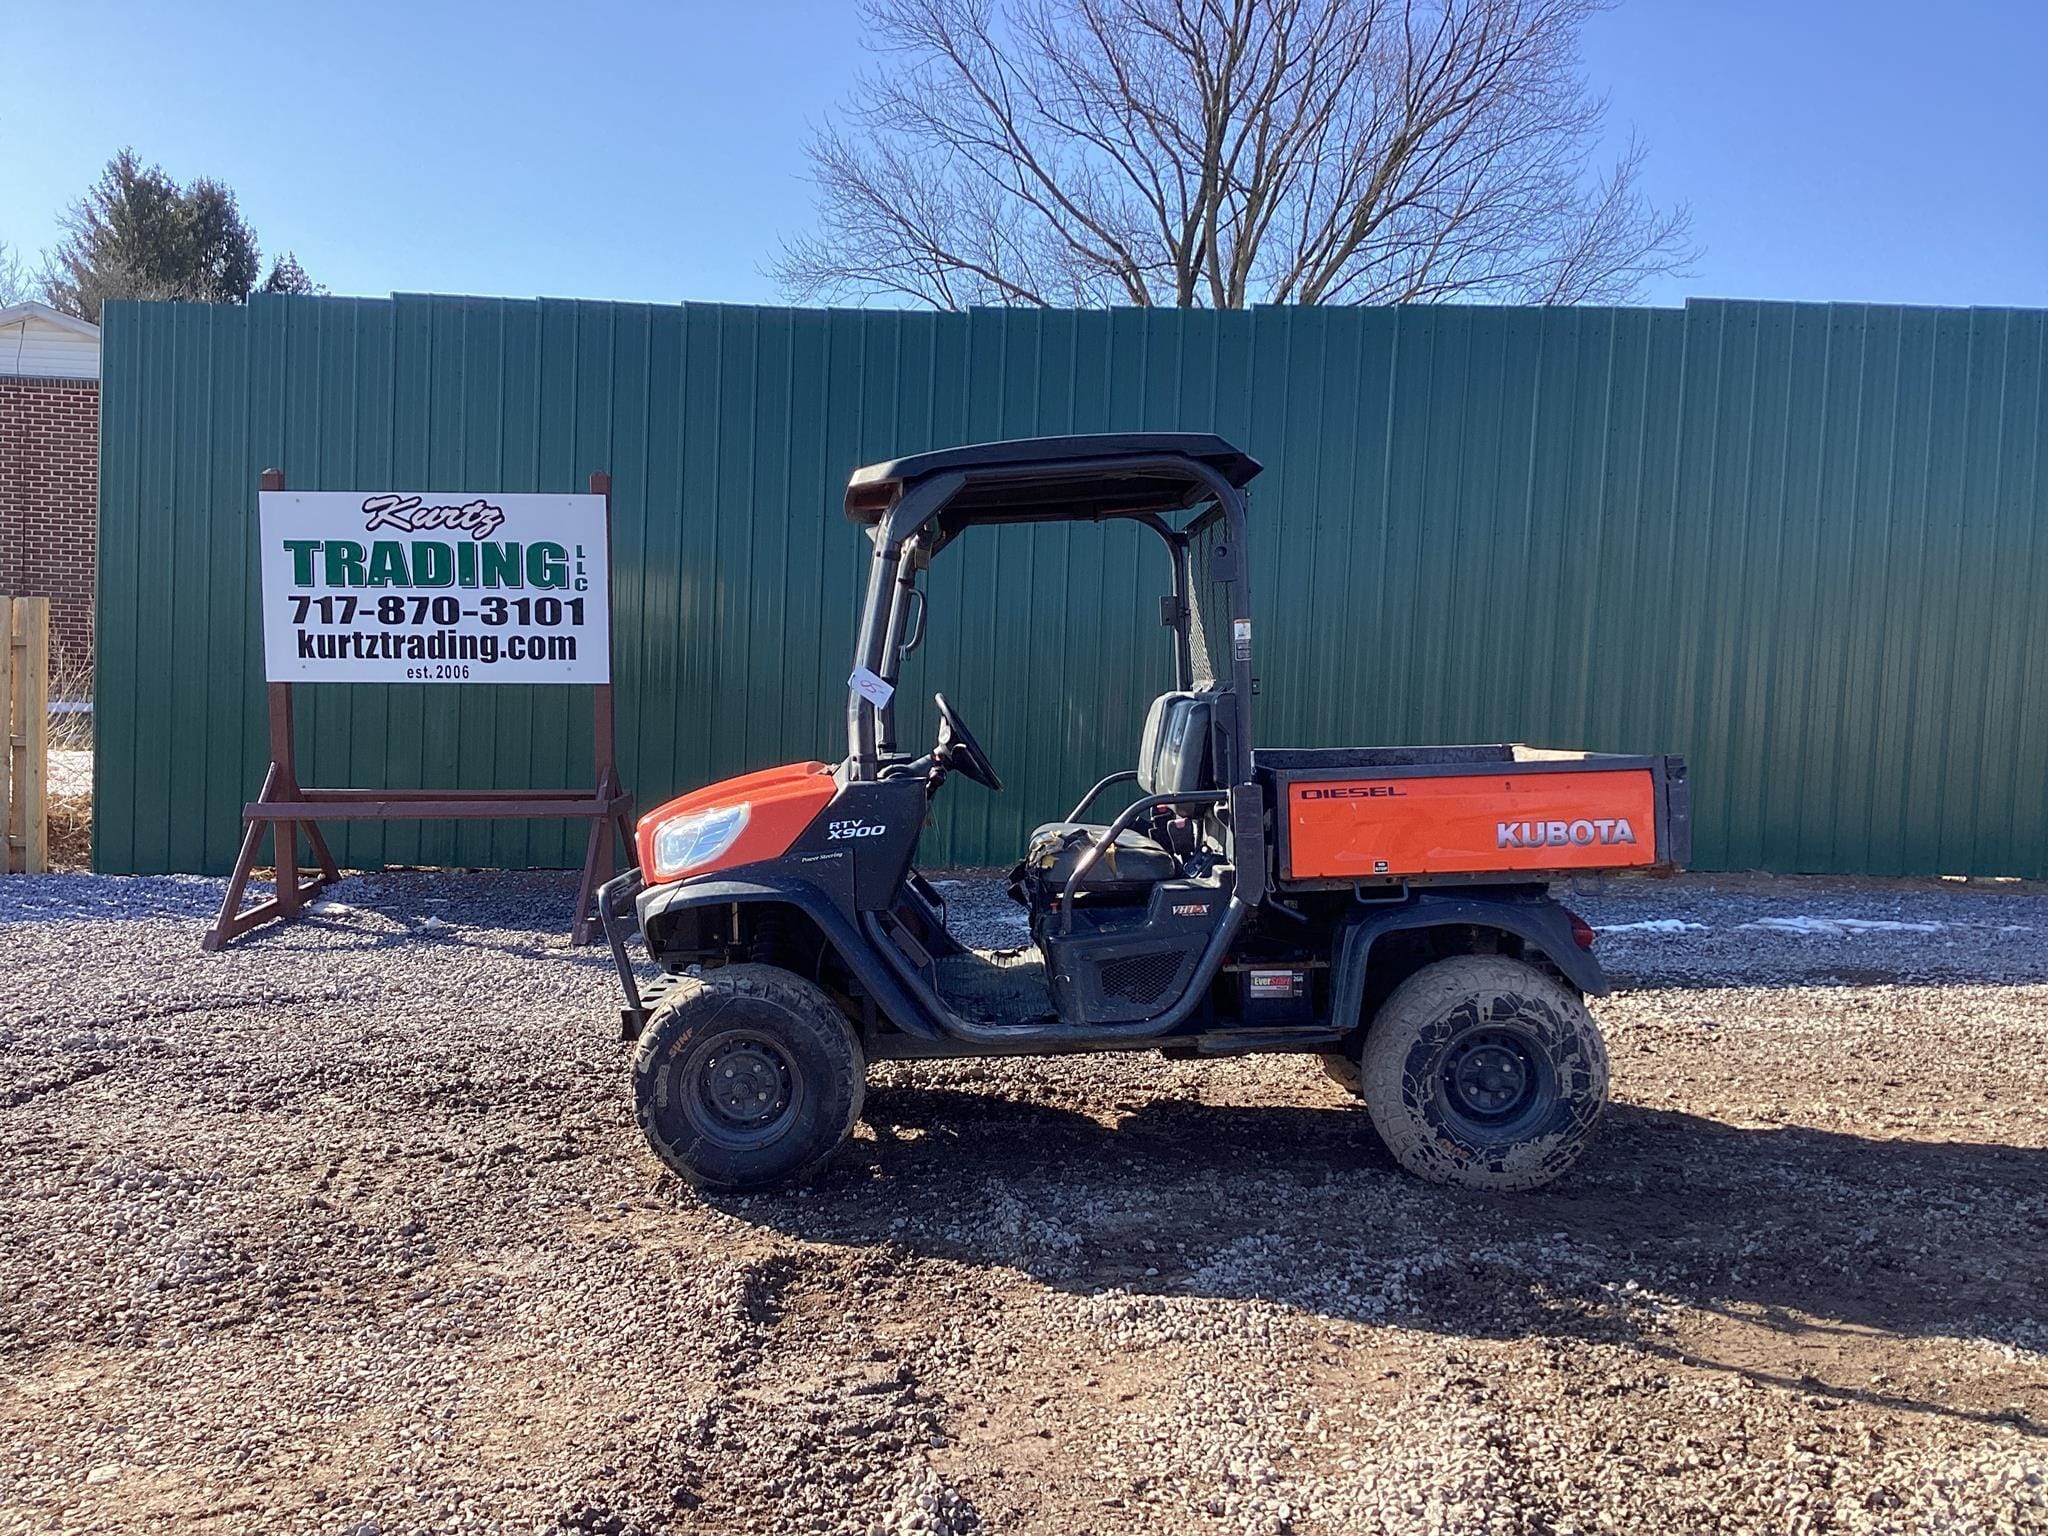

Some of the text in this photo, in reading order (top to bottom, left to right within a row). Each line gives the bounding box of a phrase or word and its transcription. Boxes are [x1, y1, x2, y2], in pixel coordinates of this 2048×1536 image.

[362, 495, 505, 540] Kurtz
[283, 540, 570, 590] TRADING
[575, 545, 588, 591] LLC
[288, 595, 584, 626] 717-870-3101
[297, 629, 577, 663] kurtztrading.com
[407, 665, 469, 679] est. 2006
[1301, 786, 1407, 799] DIESEL
[827, 825, 886, 840] X900
[829, 819, 863, 830] RTV
[1497, 818, 1637, 848] KUBOTA
[1254, 976, 1289, 986] EverStart
